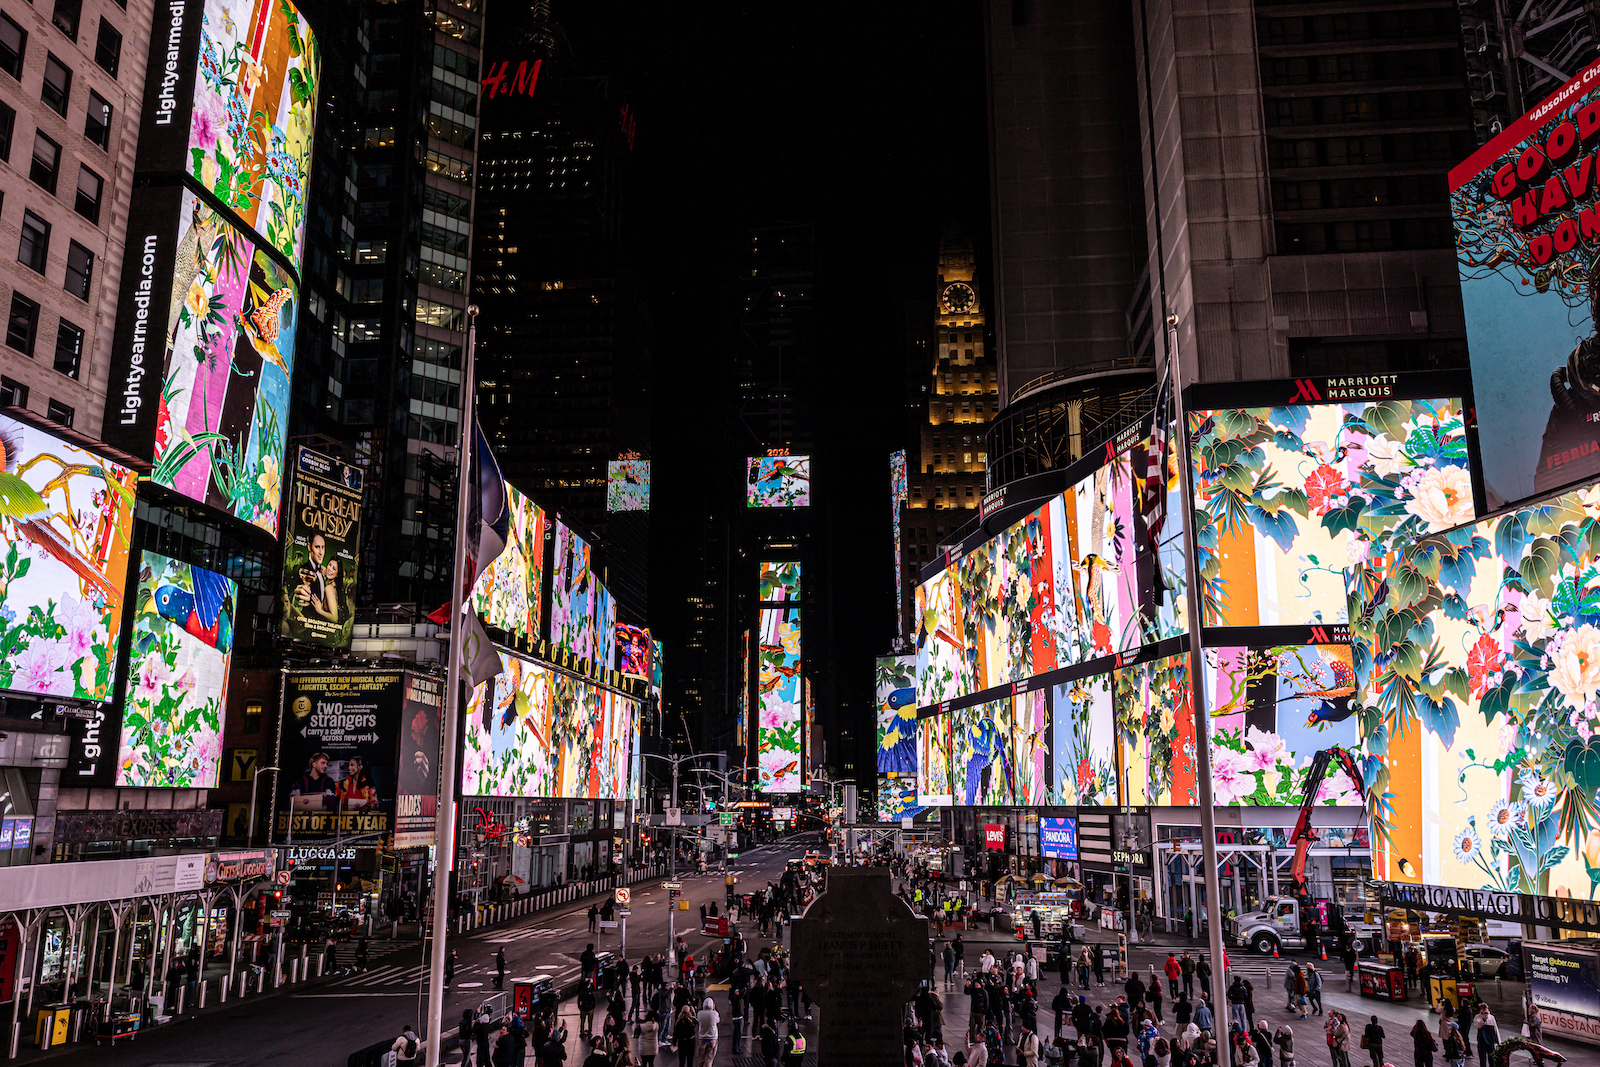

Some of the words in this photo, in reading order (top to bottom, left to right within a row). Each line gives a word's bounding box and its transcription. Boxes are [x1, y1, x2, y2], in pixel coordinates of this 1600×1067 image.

[156, 0, 186, 125] Lightyearmedi
[481, 58, 543, 99] H&M
[1491, 101, 1600, 200] GOOD
[1512, 150, 1600, 230] HAV
[121, 235, 158, 425] Lightyearmedia.com
[1328, 375, 1397, 387] MARRIOTT
[1328, 387, 1391, 400] MARQUIS
[1117, 421, 1142, 443] MARRIOTT
[1117, 433, 1140, 453] MARQUIS
[767, 448, 790, 457] 2026
[297, 483, 319, 508] THE
[320, 492, 361, 522] GREAT
[302, 507, 353, 537] GATSBY
[351, 676, 374, 684] MUSICAL
[561, 648, 637, 697] BROADWAY
[317, 700, 343, 715] two
[310, 713, 377, 731] strangers
[307, 728, 324, 738] carry
[330, 728, 345, 736] cake
[358, 733, 372, 743] york
[235, 756, 256, 779] Y
[121, 819, 177, 836] EXPRESS
[311, 816, 328, 831] OF
[356, 816, 387, 830] YEAR
[1046, 830, 1071, 843] PANDORA
[290, 848, 356, 860] LUGGAGE
[1384, 883, 1470, 911] AMERICAN
[818, 941, 857, 950] FRANCIS
[870, 941, 902, 950] DUFFY
[1531, 954, 1548, 964] Target
[1549, 957, 1580, 970] @uber.com
[1532, 964, 1549, 972] emails
[1533, 971, 1560, 985] Streaming
[1560, 976, 1569, 985] TV
